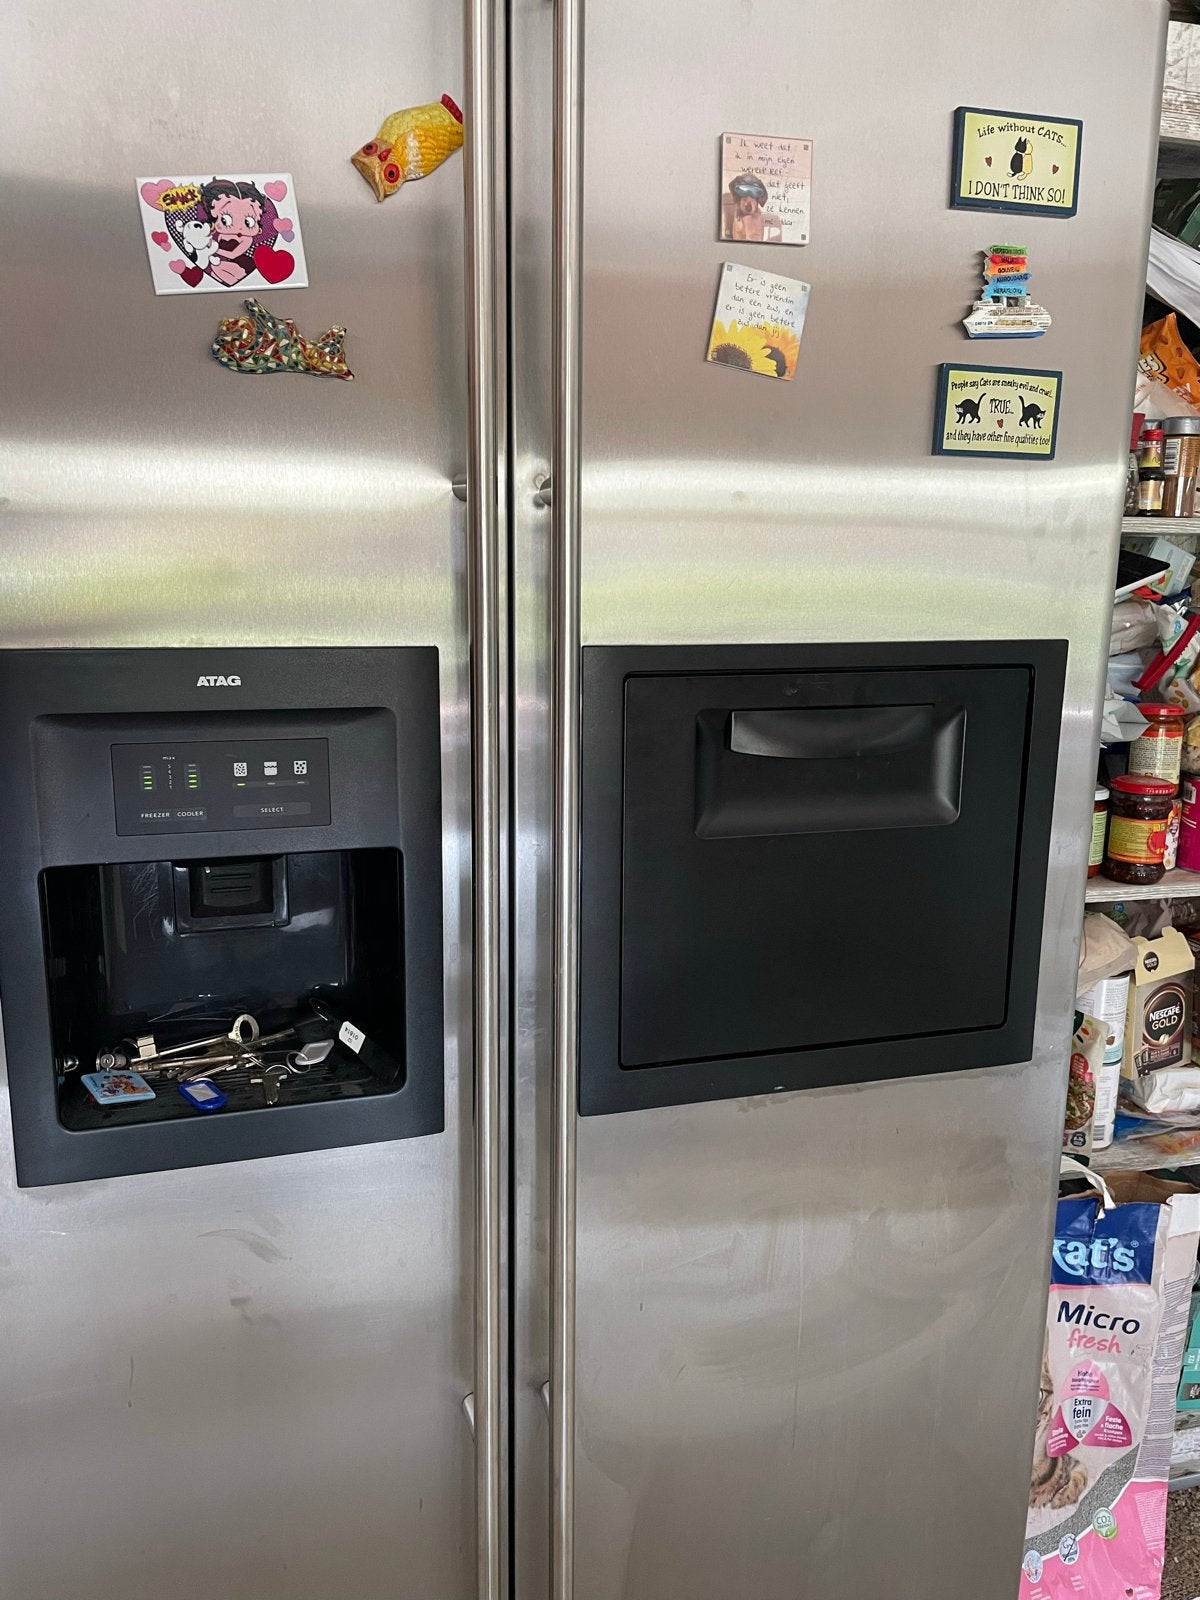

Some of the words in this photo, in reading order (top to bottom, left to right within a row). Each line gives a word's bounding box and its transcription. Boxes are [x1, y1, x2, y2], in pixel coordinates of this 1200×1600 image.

[977, 124, 995, 138] Life
[997, 122, 1035, 134] without
[1037, 126, 1067, 148] CATS...
[754, 141, 773, 150] weet
[778, 143, 791, 152] dat
[777, 156, 795, 168] eigen
[162, 189, 198, 206] SMACK
[968, 180, 973, 195] I
[975, 180, 1010, 198] DON'T
[1011, 184, 1045, 201] THINK
[1047, 187, 1066, 204] SO!
[779, 205, 805, 215] kennen
[735, 282, 761, 297] betere
[746, 273, 757, 283] Er
[760, 277, 766, 287] is
[769, 282, 787, 294] geen
[731, 294, 745, 303] dan
[749, 299, 762, 308] een
[785, 308, 794, 316] en
[738, 306, 745, 315] is
[748, 310, 766, 321] geen
[770, 314, 796, 328] betere
[951, 380, 969, 391] People
[969, 380, 979, 389] say
[979, 377, 992, 387] Cats
[992, 379, 1001, 387] are
[1001, 379, 1019, 391] sneaky
[1019, 381, 1029, 391] evil
[1029, 384, 1039, 393] and
[946, 429, 957, 441] and
[957, 430, 971, 444] they
[971, 431, 986, 441] have
[986, 431, 1003, 443] other
[1003, 431, 1015, 443] fine
[1014, 434, 1039, 448] qualities
[196, 675, 242, 687] ATAG
[177, 810, 204, 818] COOLER
[1151, 1015, 1178, 1030] GOLD
[1057, 1300, 1141, 1335] Micro
[1066, 1327, 1122, 1355] fresh
[1074, 1398, 1092, 1406] Extra
[1072, 1406, 1092, 1419] fein
[1105, 1415, 1122, 1423] Feste
